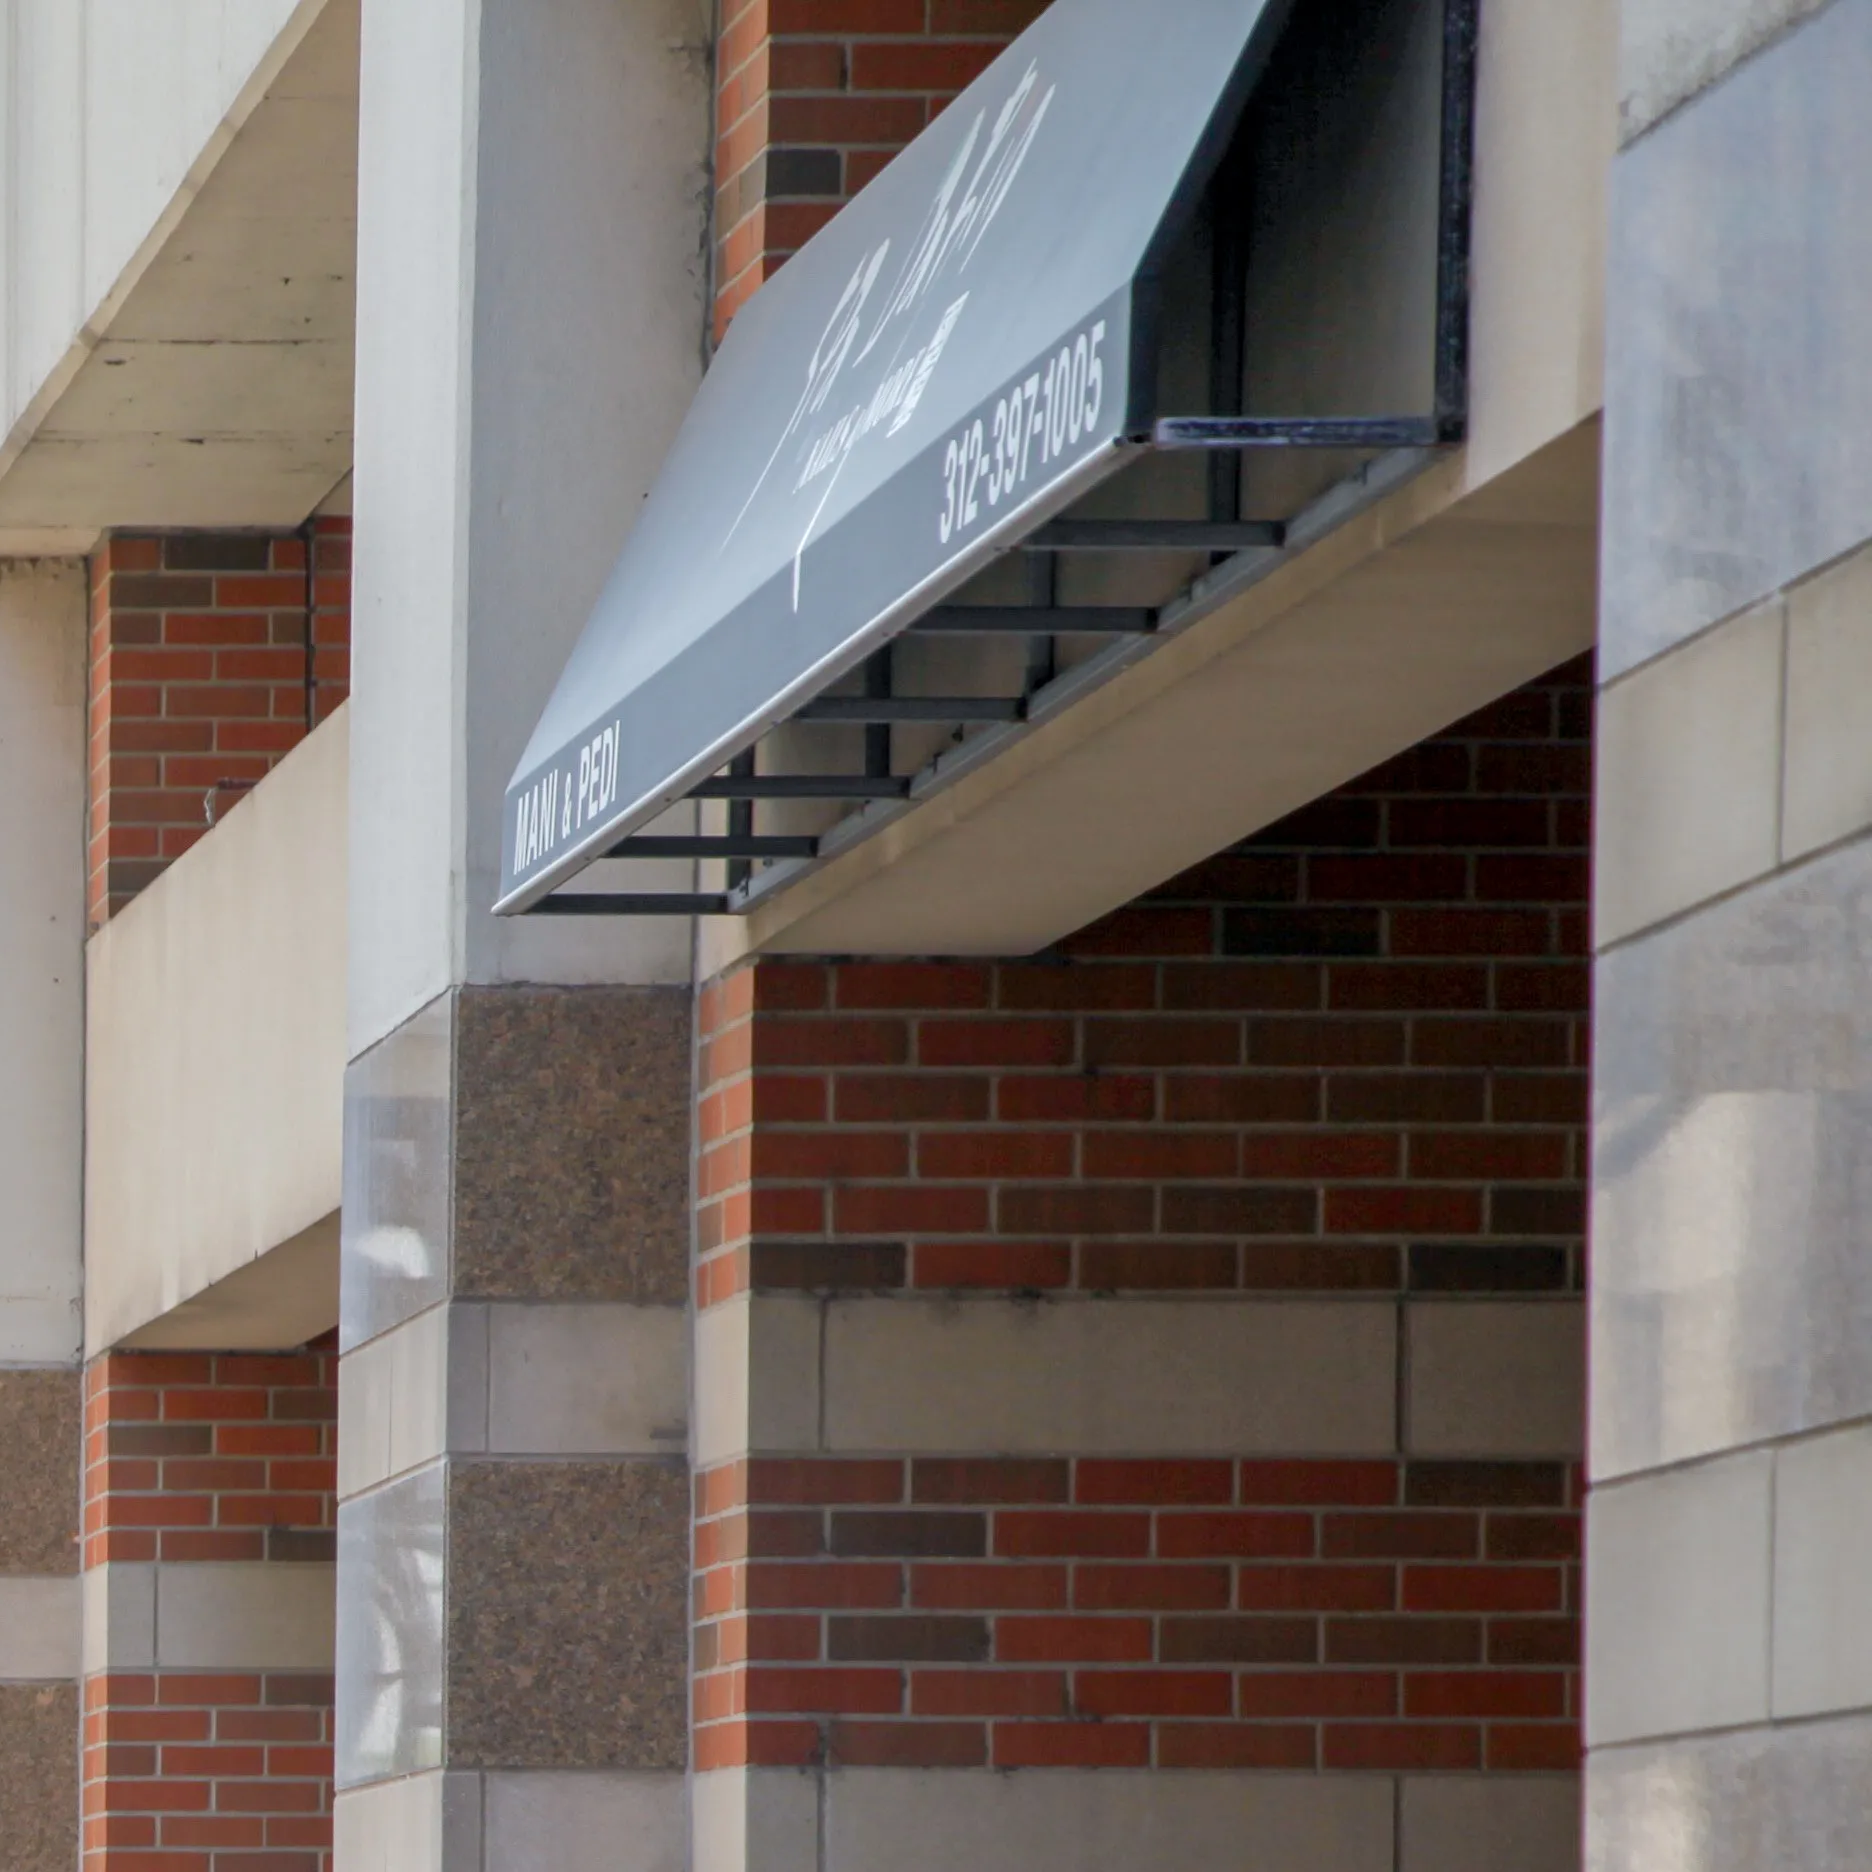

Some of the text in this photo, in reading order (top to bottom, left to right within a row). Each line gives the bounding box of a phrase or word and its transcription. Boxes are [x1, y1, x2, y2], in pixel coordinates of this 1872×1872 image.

[940, 319, 1105, 544] 312-397-1005
[514, 720, 620, 875] MANI & PEDI
